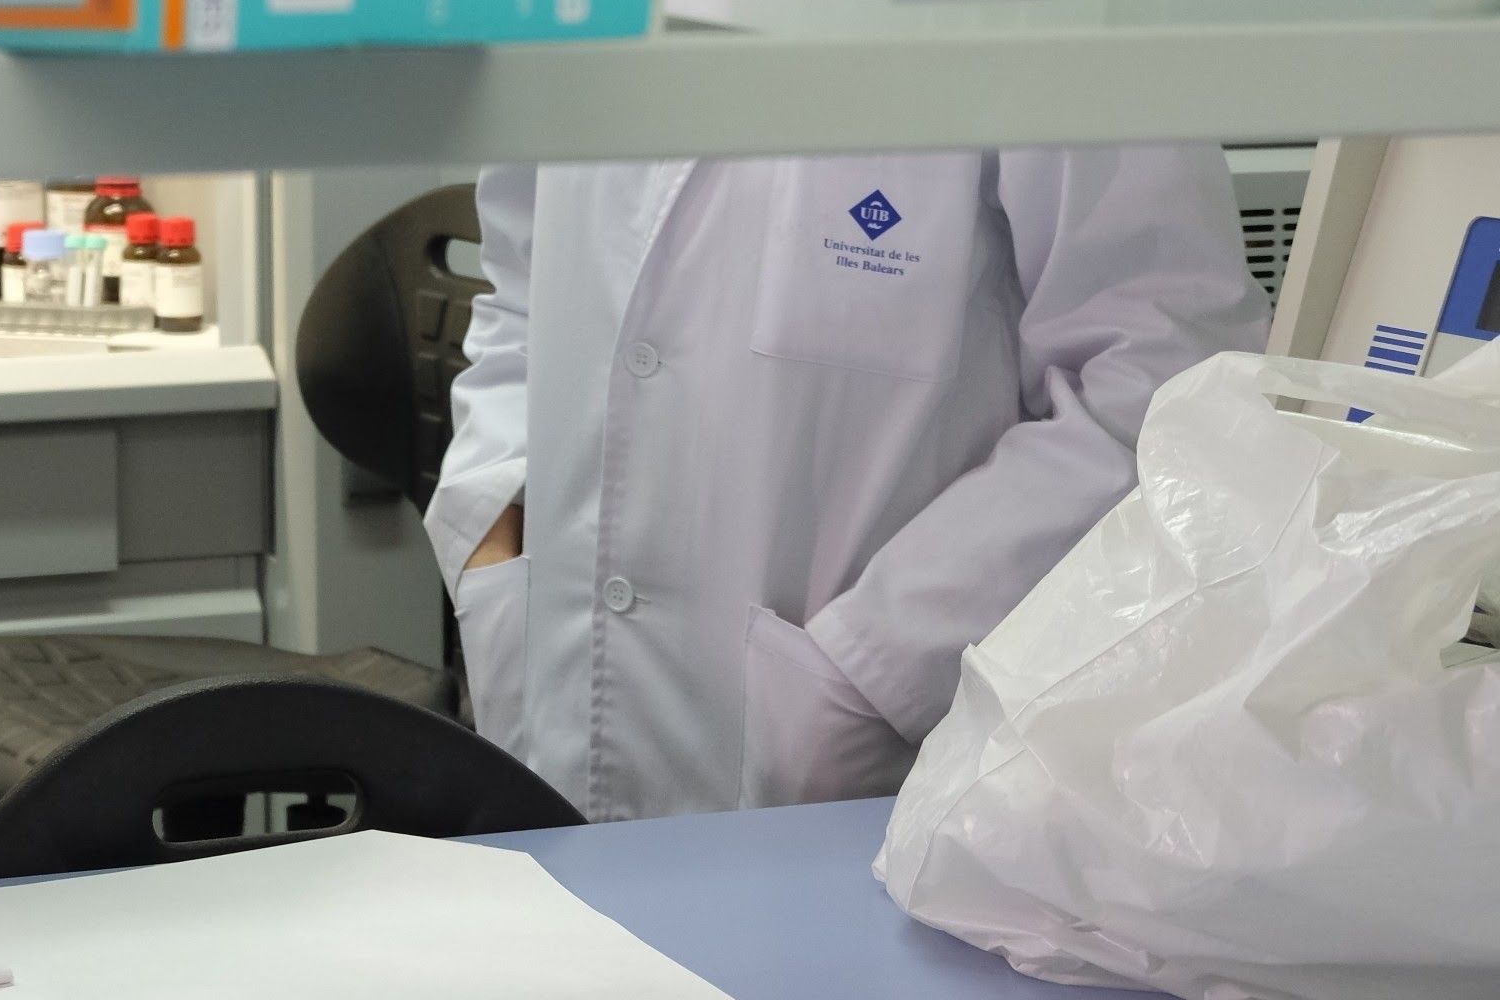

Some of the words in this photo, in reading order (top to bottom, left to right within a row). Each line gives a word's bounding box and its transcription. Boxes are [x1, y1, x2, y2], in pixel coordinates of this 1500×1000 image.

[860, 207, 890, 222] UIB
[823, 238, 885, 258] Universitat
[888, 249, 902, 261] de
[905, 251, 921, 263] les
[836, 255, 859, 269] Illes
[862, 260, 905, 276] Balears
